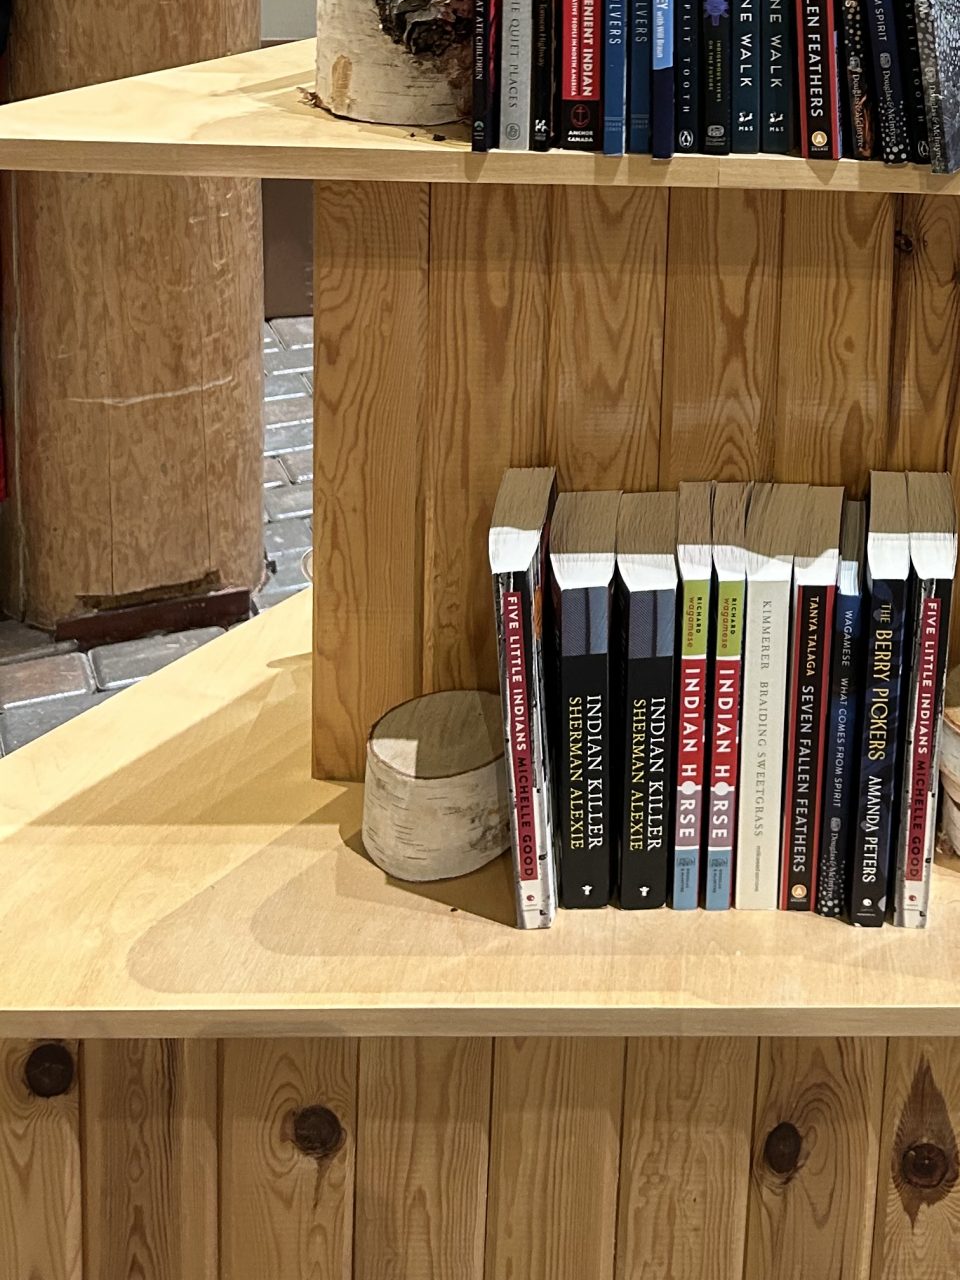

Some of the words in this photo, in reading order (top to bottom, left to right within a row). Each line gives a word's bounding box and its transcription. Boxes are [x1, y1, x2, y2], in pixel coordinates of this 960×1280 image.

[475, 15, 484, 34] ATE
[509, 19, 520, 57] QUIET
[875, 8, 888, 42] SPIRIT
[475, 35, 484, 80] CHILDREN
[583, 48, 593, 96] INDIAN
[682, 57, 690, 112] TOOTH
[740, 33, 752, 87] WALK
[770, 35, 782, 88] WALK
[807, 33, 824, 117] FEATHERS
[508, 63, 519, 109] PLACES
[507, 596, 519, 629] FIVE
[687, 597, 695, 648] wagamese
[721, 598, 730, 649] wagamese
[761, 601, 772, 670] KIMMERER
[809, 596, 819, 631] TANYA
[842, 611, 853, 667] WAGAMESE
[880, 603, 891, 624] THE
[925, 602, 938, 635] FIVE
[509, 635, 523, 683] LITTLE
[806, 633, 818, 676] TALAGA
[873, 630, 893, 682] BERRY
[922, 641, 935, 687] LITTLE
[682, 668, 701, 752] INDIAN
[716, 670, 735, 753] INDIAN
[757, 681, 769, 747] BRAIDING
[801, 686, 814, 733] SEVEN
[839, 678, 849, 706] WHAT
[513, 689, 527, 751] INDIANS
[568, 697, 583, 782] SHERMAN
[586, 694, 602, 770] INDIAN
[632, 699, 646, 783] SHERMAN
[649, 698, 666, 773] INDIAN
[836, 708, 847, 744] COMES
[867, 688, 889, 761] PICKERS
[918, 693, 932, 754] INDIANS
[797, 739, 812, 793] FALLEN
[834, 746, 845, 775] FROM
[517, 757, 531, 828] MICHELLE
[570, 788, 584, 850] ALEXIE
[587, 778, 603, 850] KILLER
[647, 781, 664, 851] KILLER
[680, 764, 697, 838] HORSE
[712, 765, 730, 839] HORSE
[754, 751, 766, 837] SWEETGRASS
[832, 777, 842, 807] SPIRIT
[865, 775, 882, 833] AMANDA
[912, 760, 926, 830] MICHELLE
[629, 790, 644, 851] ALEXIE
[793, 799, 809, 872] FEATHERS
[522, 836, 534, 876] GOOD
[862, 836, 879, 883] PETERS
[909, 836, 920, 877] GOOD
